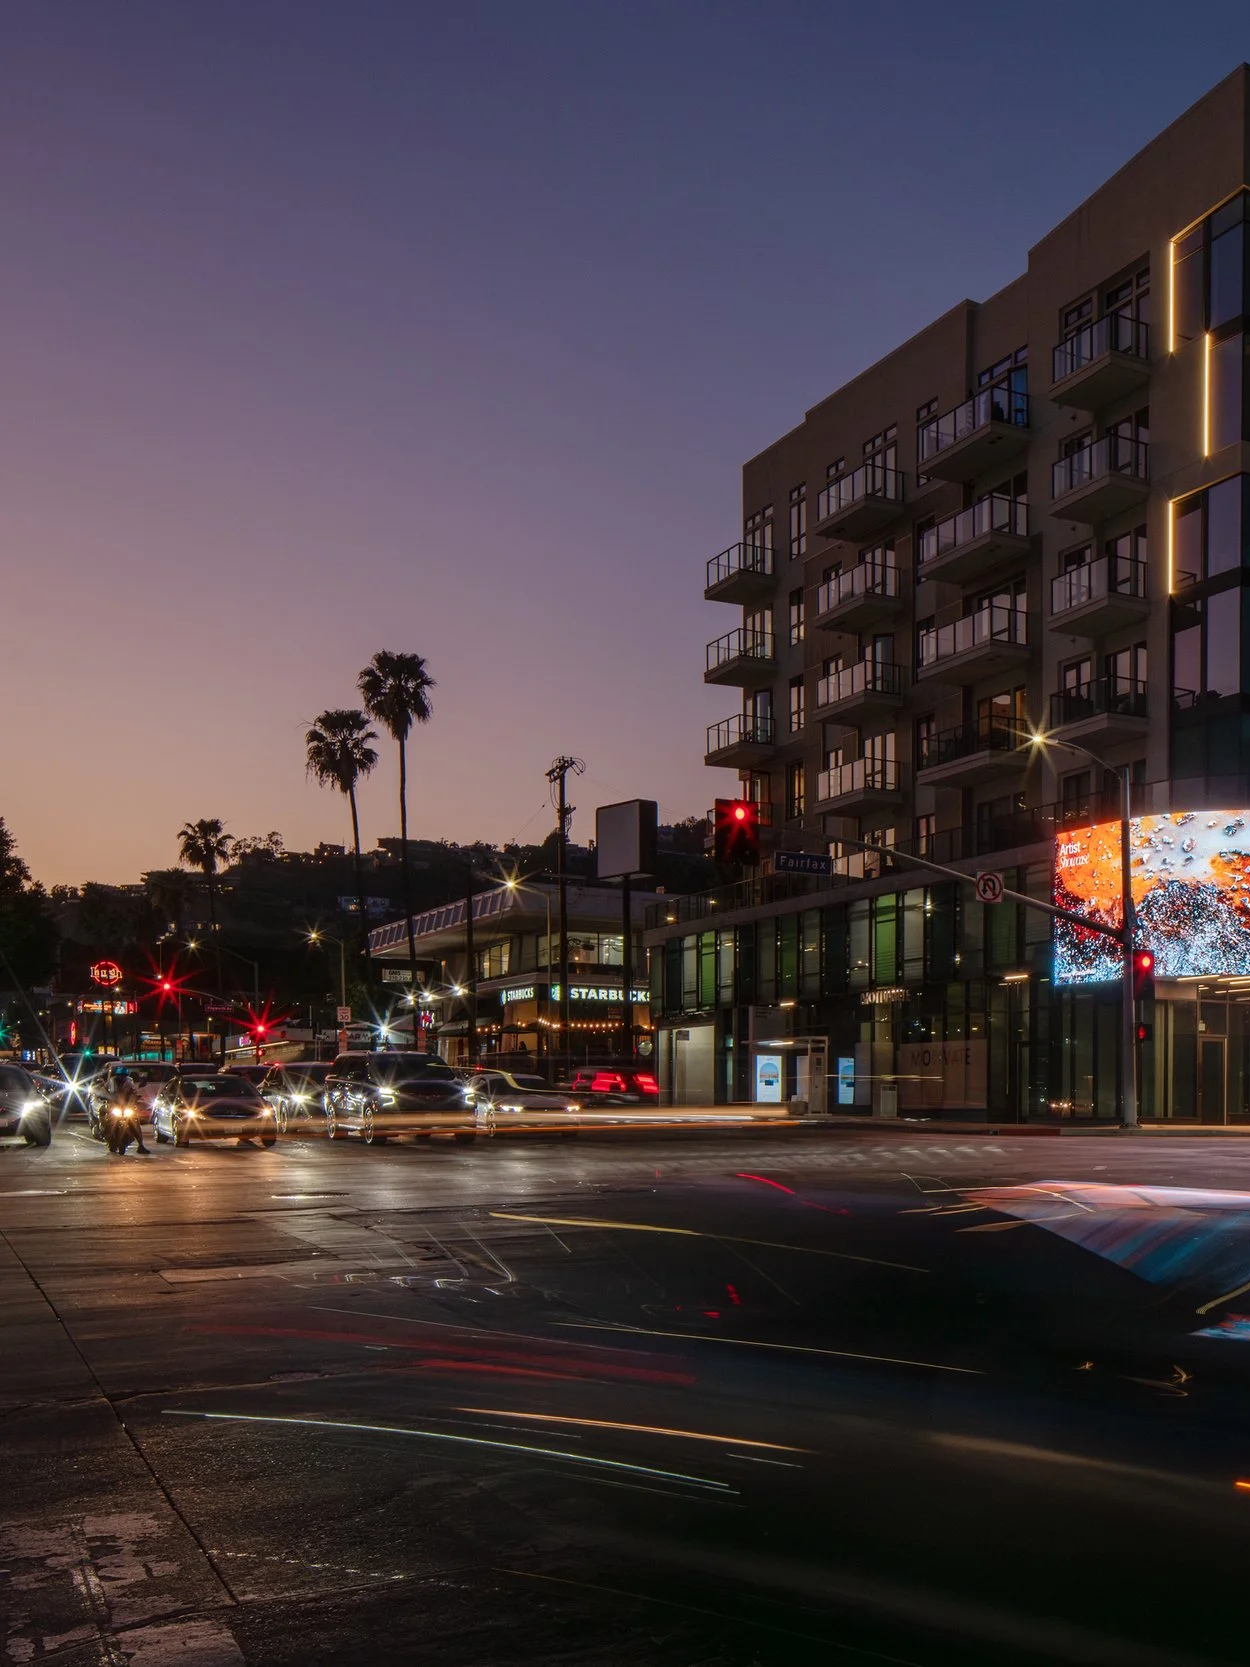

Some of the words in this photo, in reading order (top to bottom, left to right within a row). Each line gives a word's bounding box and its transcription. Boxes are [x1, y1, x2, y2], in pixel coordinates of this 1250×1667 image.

[1059, 841, 1081, 856] Artist
[780, 855, 826, 870] Fairfax
[507, 987, 534, 1002] STARBUCKS
[911, 1047, 971, 1068] MOVATE
